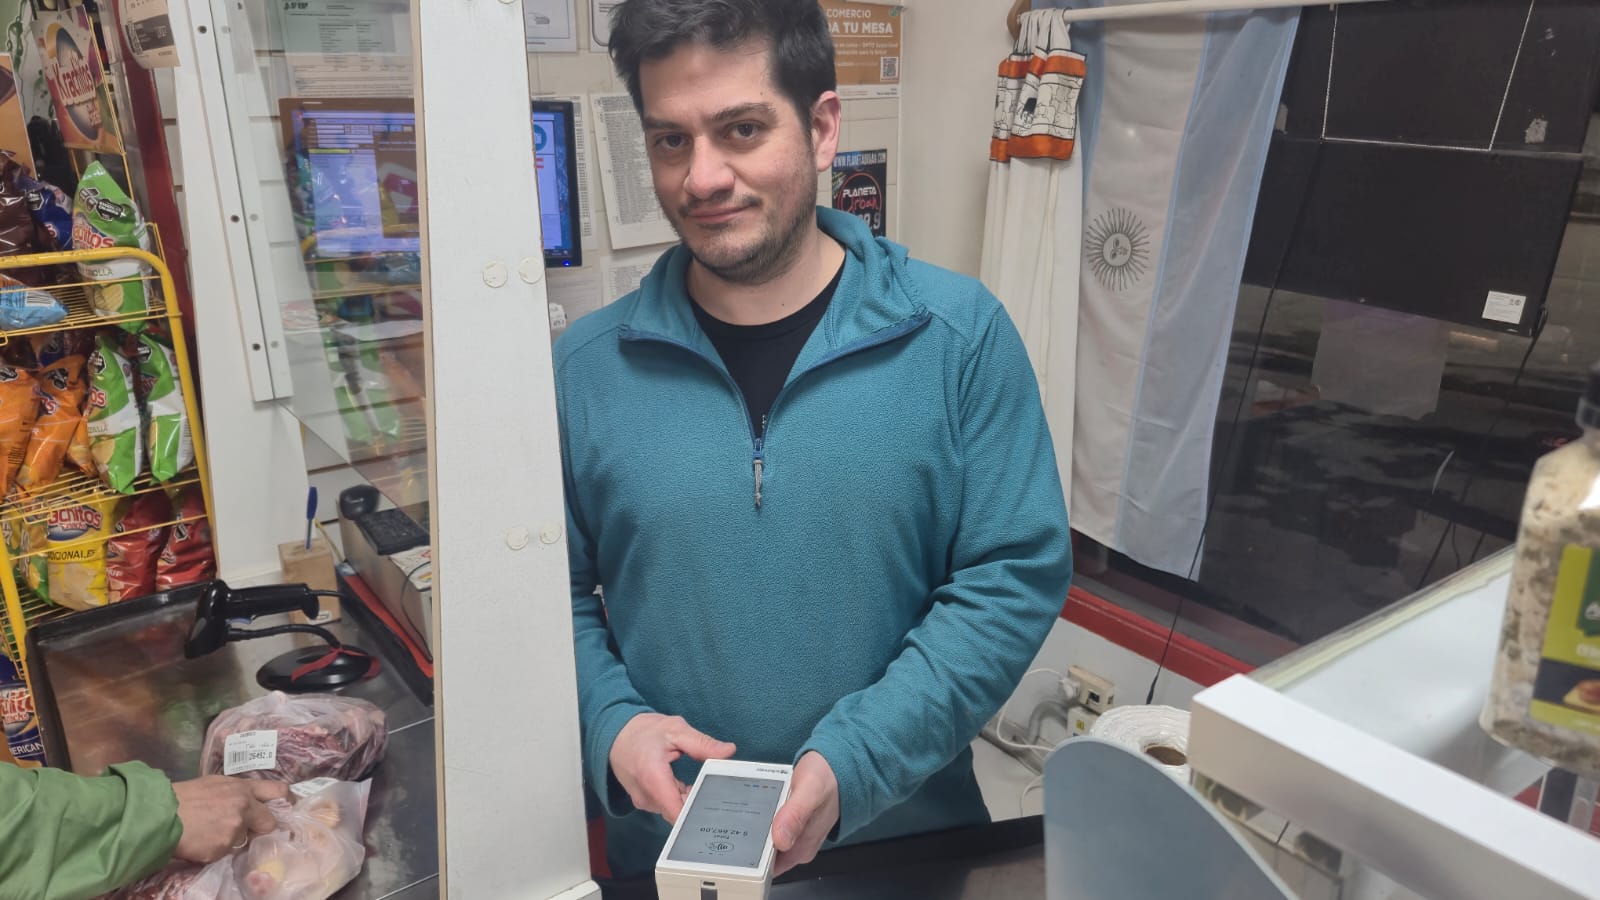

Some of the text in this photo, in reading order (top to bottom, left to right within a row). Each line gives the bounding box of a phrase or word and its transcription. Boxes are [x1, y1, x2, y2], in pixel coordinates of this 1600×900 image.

[826, 8, 872, 18] COMERCIO
[843, 22, 859, 33] TU
[862, 22, 893, 34] MESA
[843, 186, 877, 198] PLANETA
